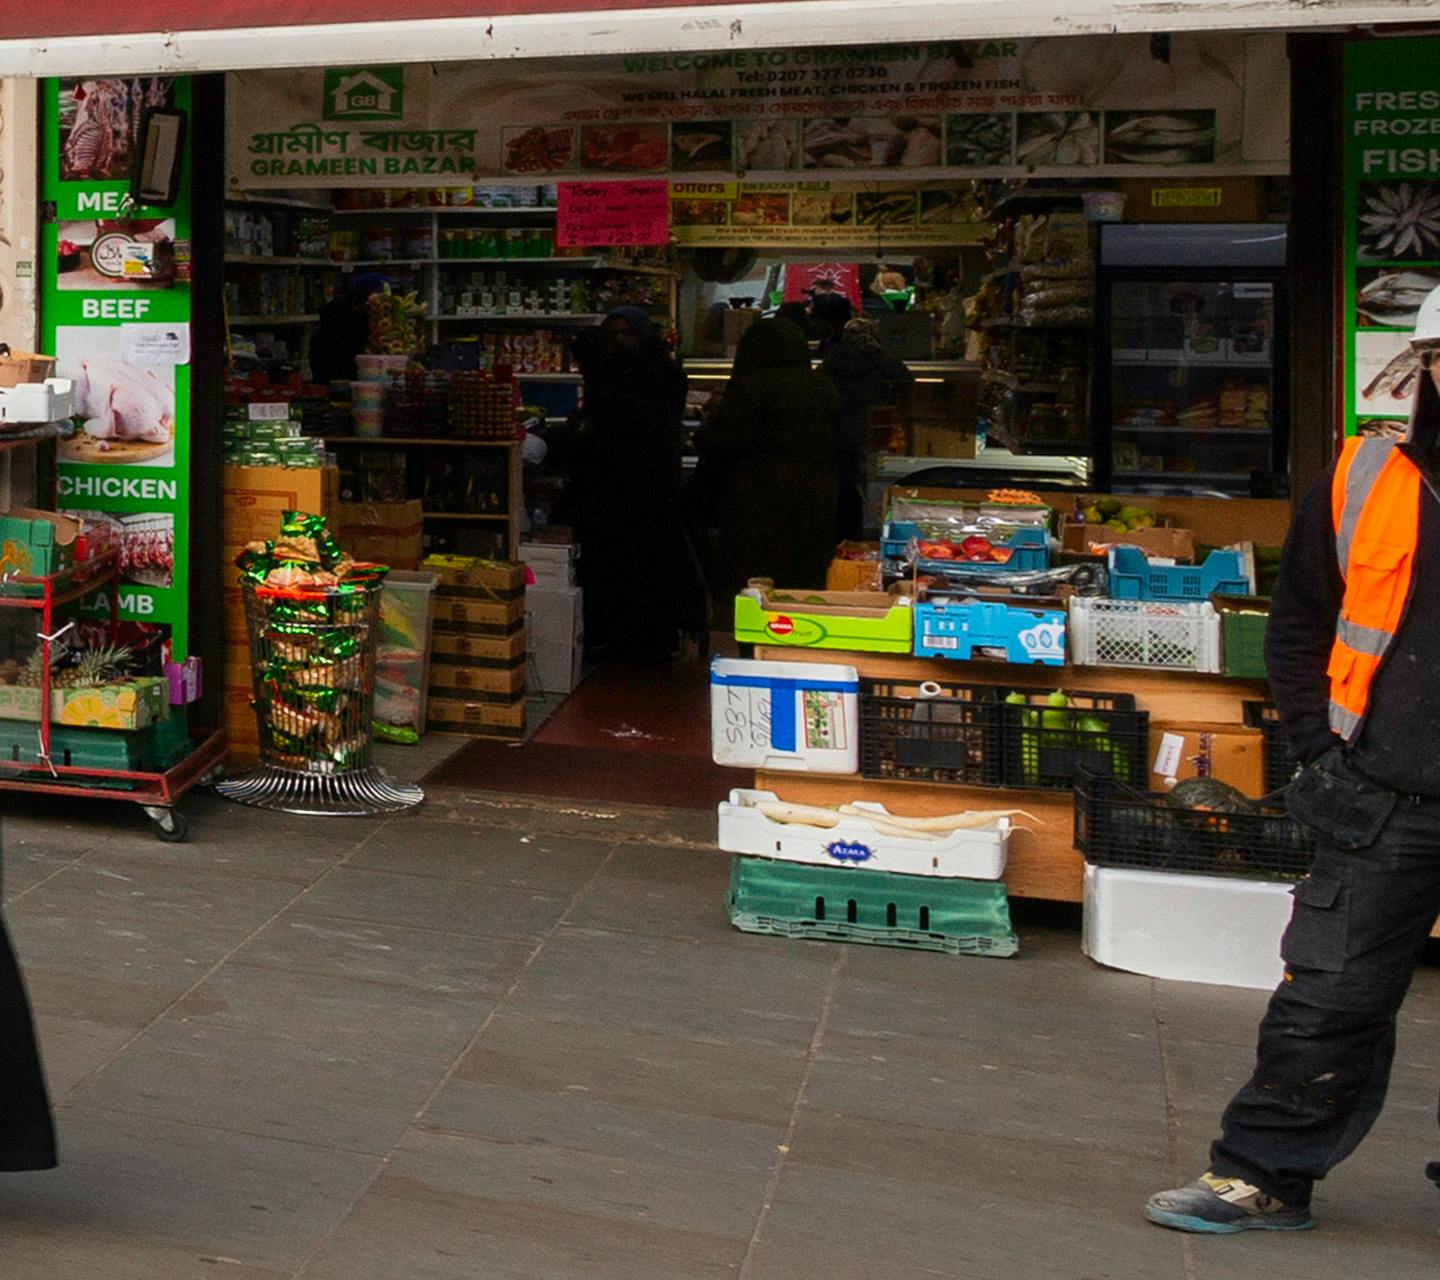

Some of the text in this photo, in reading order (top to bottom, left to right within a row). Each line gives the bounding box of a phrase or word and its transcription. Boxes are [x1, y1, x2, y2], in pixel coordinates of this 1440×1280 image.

[623, 50, 747, 73] WELCOME
[753, 49, 787, 67] TO
[737, 66, 887, 83] Tel: 0207 377 0230
[683, 89, 728, 100] HALAL
[731, 87, 776, 99] FRESH
[828, 83, 900, 95] CHICKEN
[920, 81, 981, 92] FROZEN
[985, 79, 1020, 90] FISH
[250, 155, 477, 176] GRAMEEN BAZAR
[82, 299, 150, 318] BEEF
[57, 476, 177, 500] CHICKEN
[80, 594, 154, 614] LAMB
